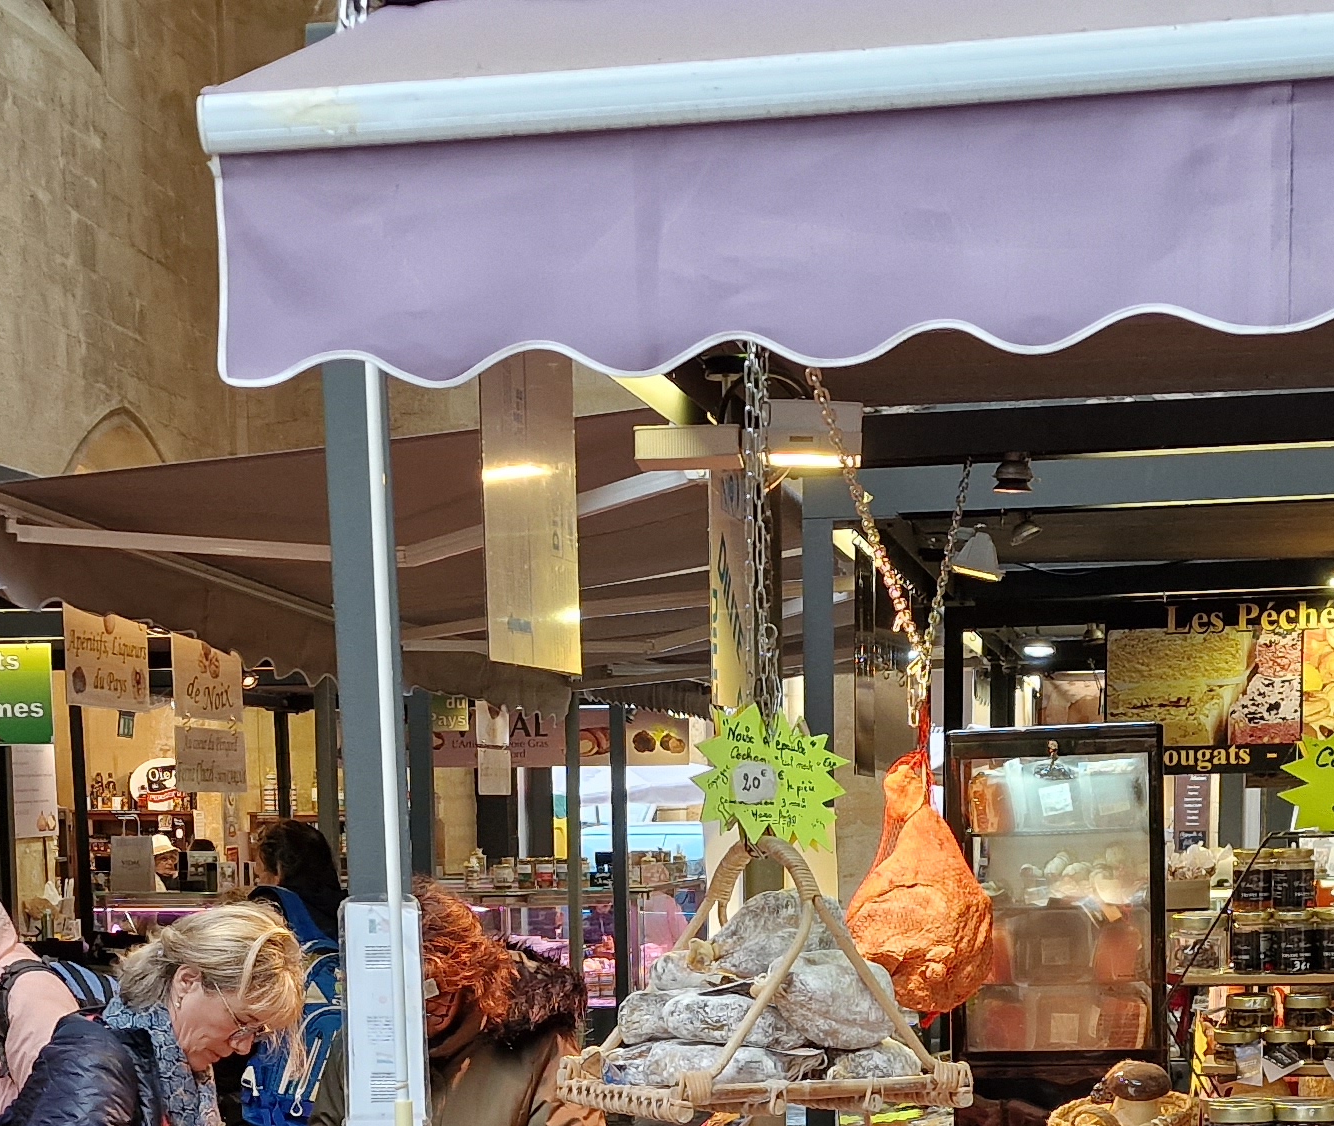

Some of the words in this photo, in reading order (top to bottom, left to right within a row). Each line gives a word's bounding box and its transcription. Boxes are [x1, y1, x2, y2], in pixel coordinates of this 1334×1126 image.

[1166, 604, 1224, 635] Les
[112, 636, 146, 662] Liqueurs
[94, 668, 105, 690] du
[107, 670, 127, 696] Pays
[187, 676, 201, 704] de
[203, 682, 233, 711] Noix
[528, 738, 549, 748] Gras
[1163, 745, 1251, 774] ougats
